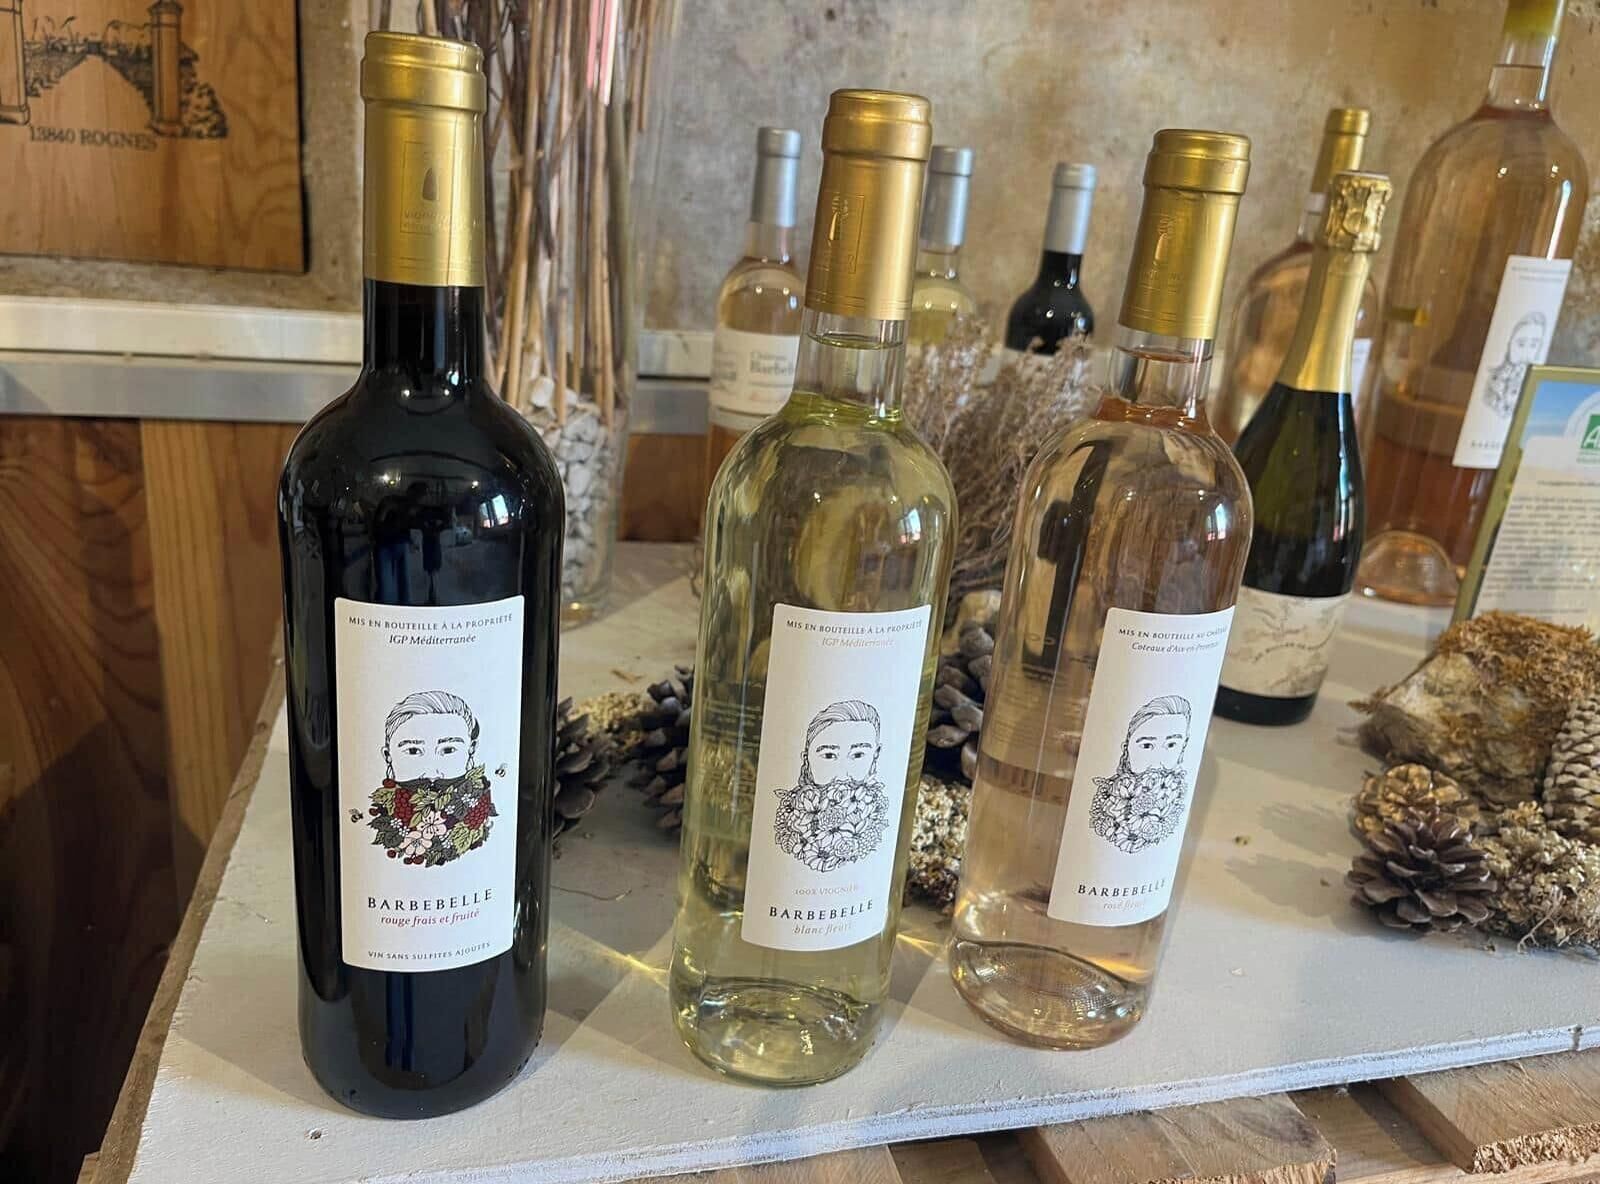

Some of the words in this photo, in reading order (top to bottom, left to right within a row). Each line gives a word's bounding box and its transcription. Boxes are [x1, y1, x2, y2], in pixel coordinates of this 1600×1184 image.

[30, 126, 76, 144] 13840
[80, 129, 157, 151] ROGNES
[348, 616, 366, 626] MIS
[368, 620, 381, 628] EN
[384, 622, 438, 631] BOUTEILLE
[466, 613, 513, 628] PROPRIÉTÉ
[786, 620, 802, 629] MIS
[804, 623, 816, 632] EN
[818, 625, 865, 634] BOUTEILLE
[1118, 628, 1135, 636] MIS
[389, 634, 408, 645] IGP
[410, 634, 476, 646] Méditerranée
[821, 637, 839, 647] IGP
[1132, 642, 1165, 653] Coteaux
[1077, 879, 1166, 897] BARBEBELLE
[368, 888, 493, 911] BARBEBELLE
[769, 899, 874, 920] BARBEBELLE
[380, 914, 411, 927] rouge
[411, 912, 438, 928] frais
[439, 914, 449, 924] et
[450, 909, 480, 926] fruité
[793, 924, 824, 935] blanc
[368, 950, 384, 958] VIN
[386, 952, 409, 960] SANS
[412, 951, 453, 960] SULFITES
